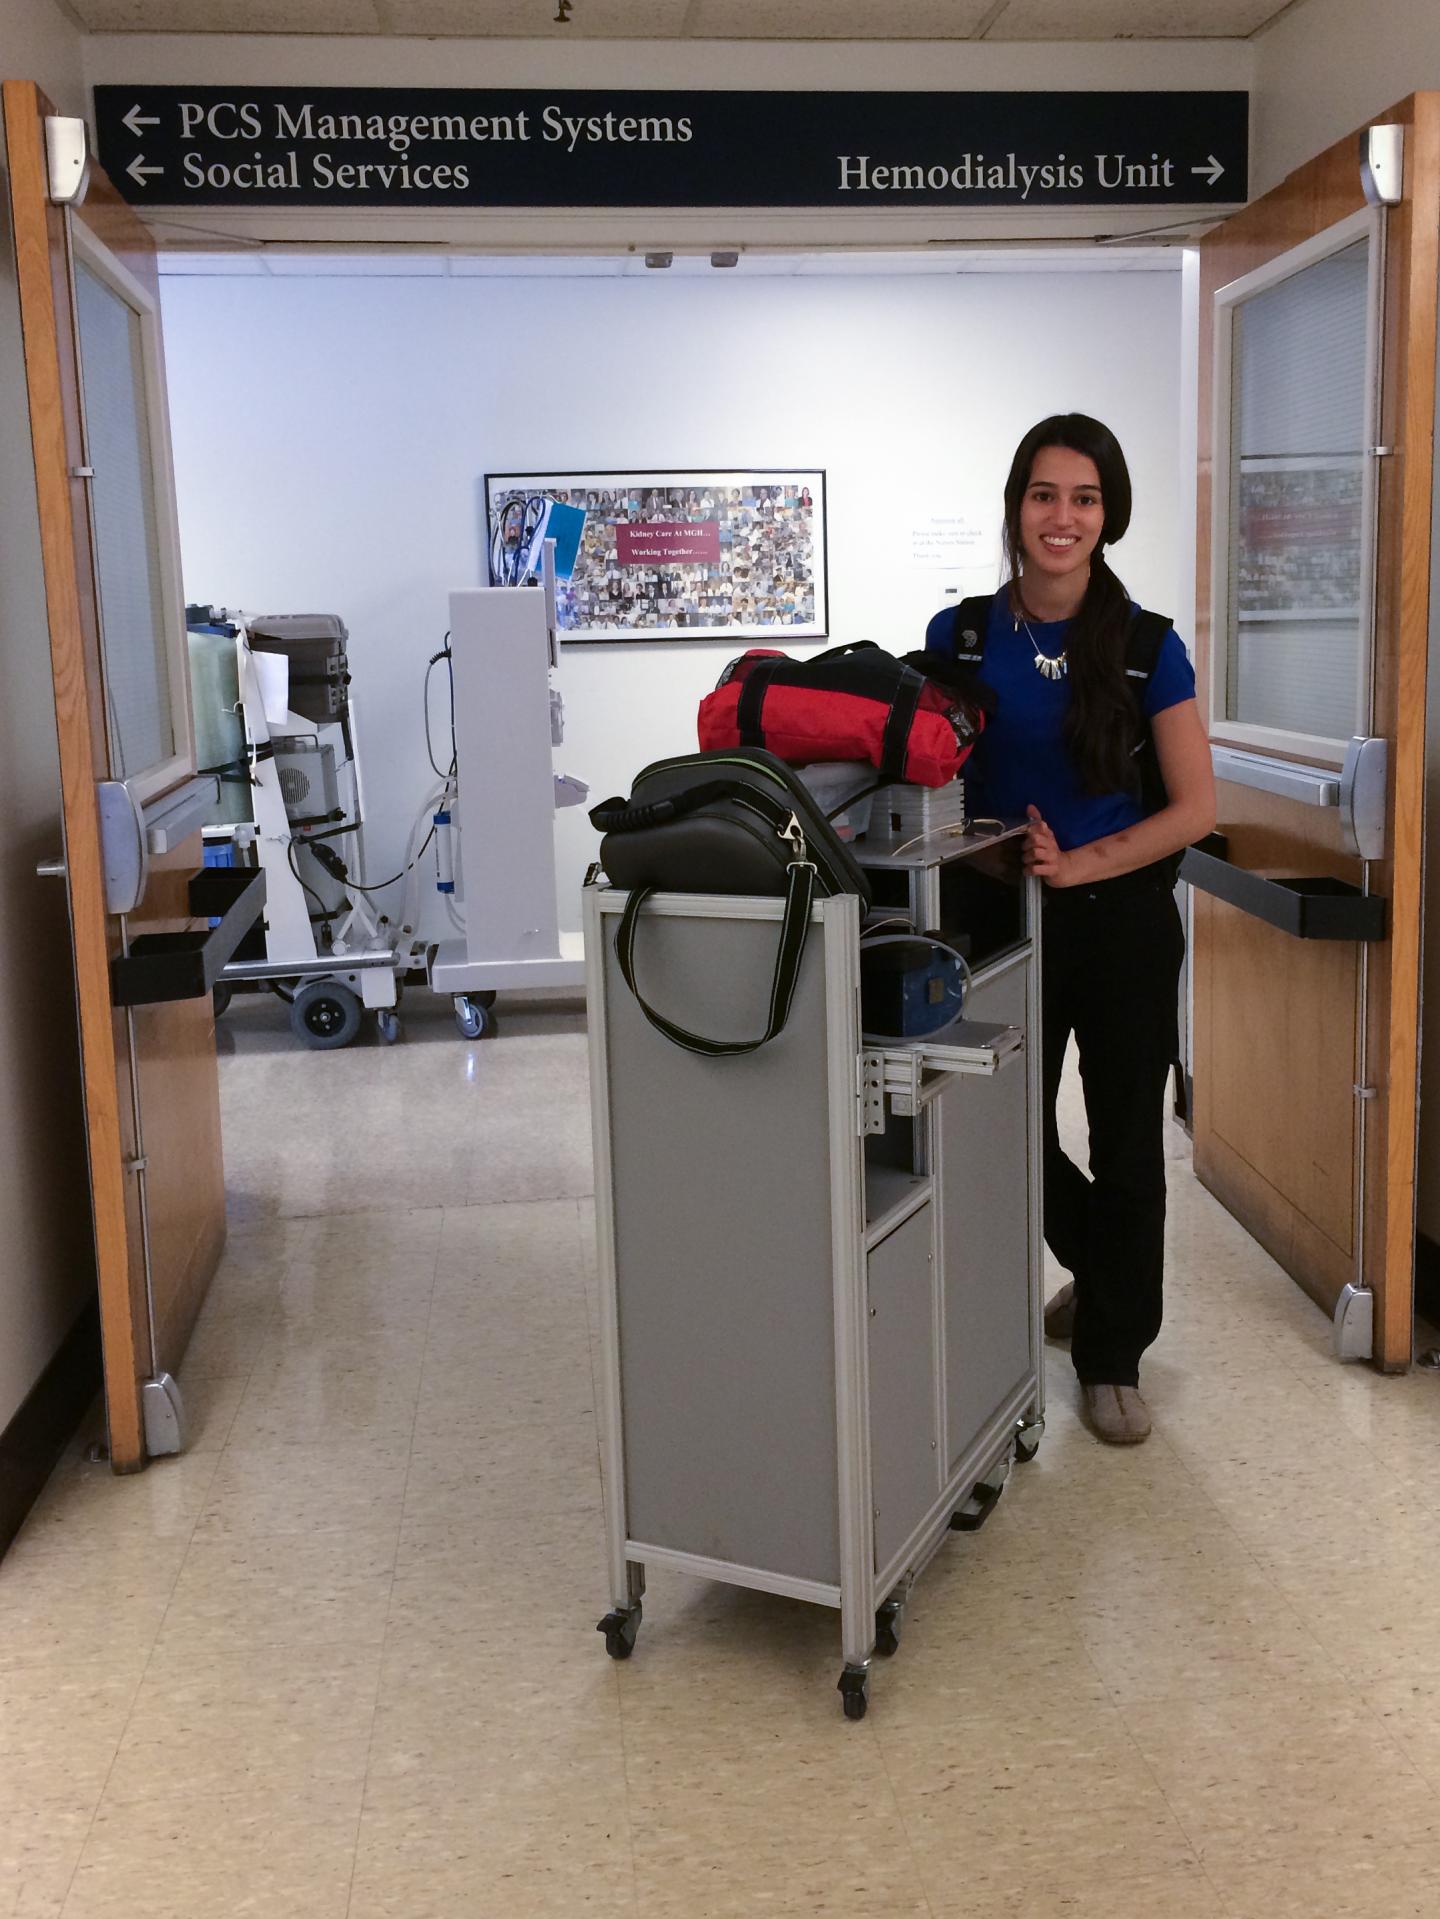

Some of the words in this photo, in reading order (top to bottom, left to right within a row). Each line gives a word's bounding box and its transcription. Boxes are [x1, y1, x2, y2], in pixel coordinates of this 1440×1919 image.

[180, 103, 262, 139] PCS
[275, 104, 531, 151] Management
[542, 105, 693, 152] Systems
[183, 151, 301, 189] Social
[313, 149, 470, 189] Services
[837, 153, 1084, 200] Hemodialysis
[1094, 153, 1174, 188] Unit
[630, 530, 654, 539] Kidney
[655, 530, 673, 538] Care
[631, 548, 662, 556] Working
